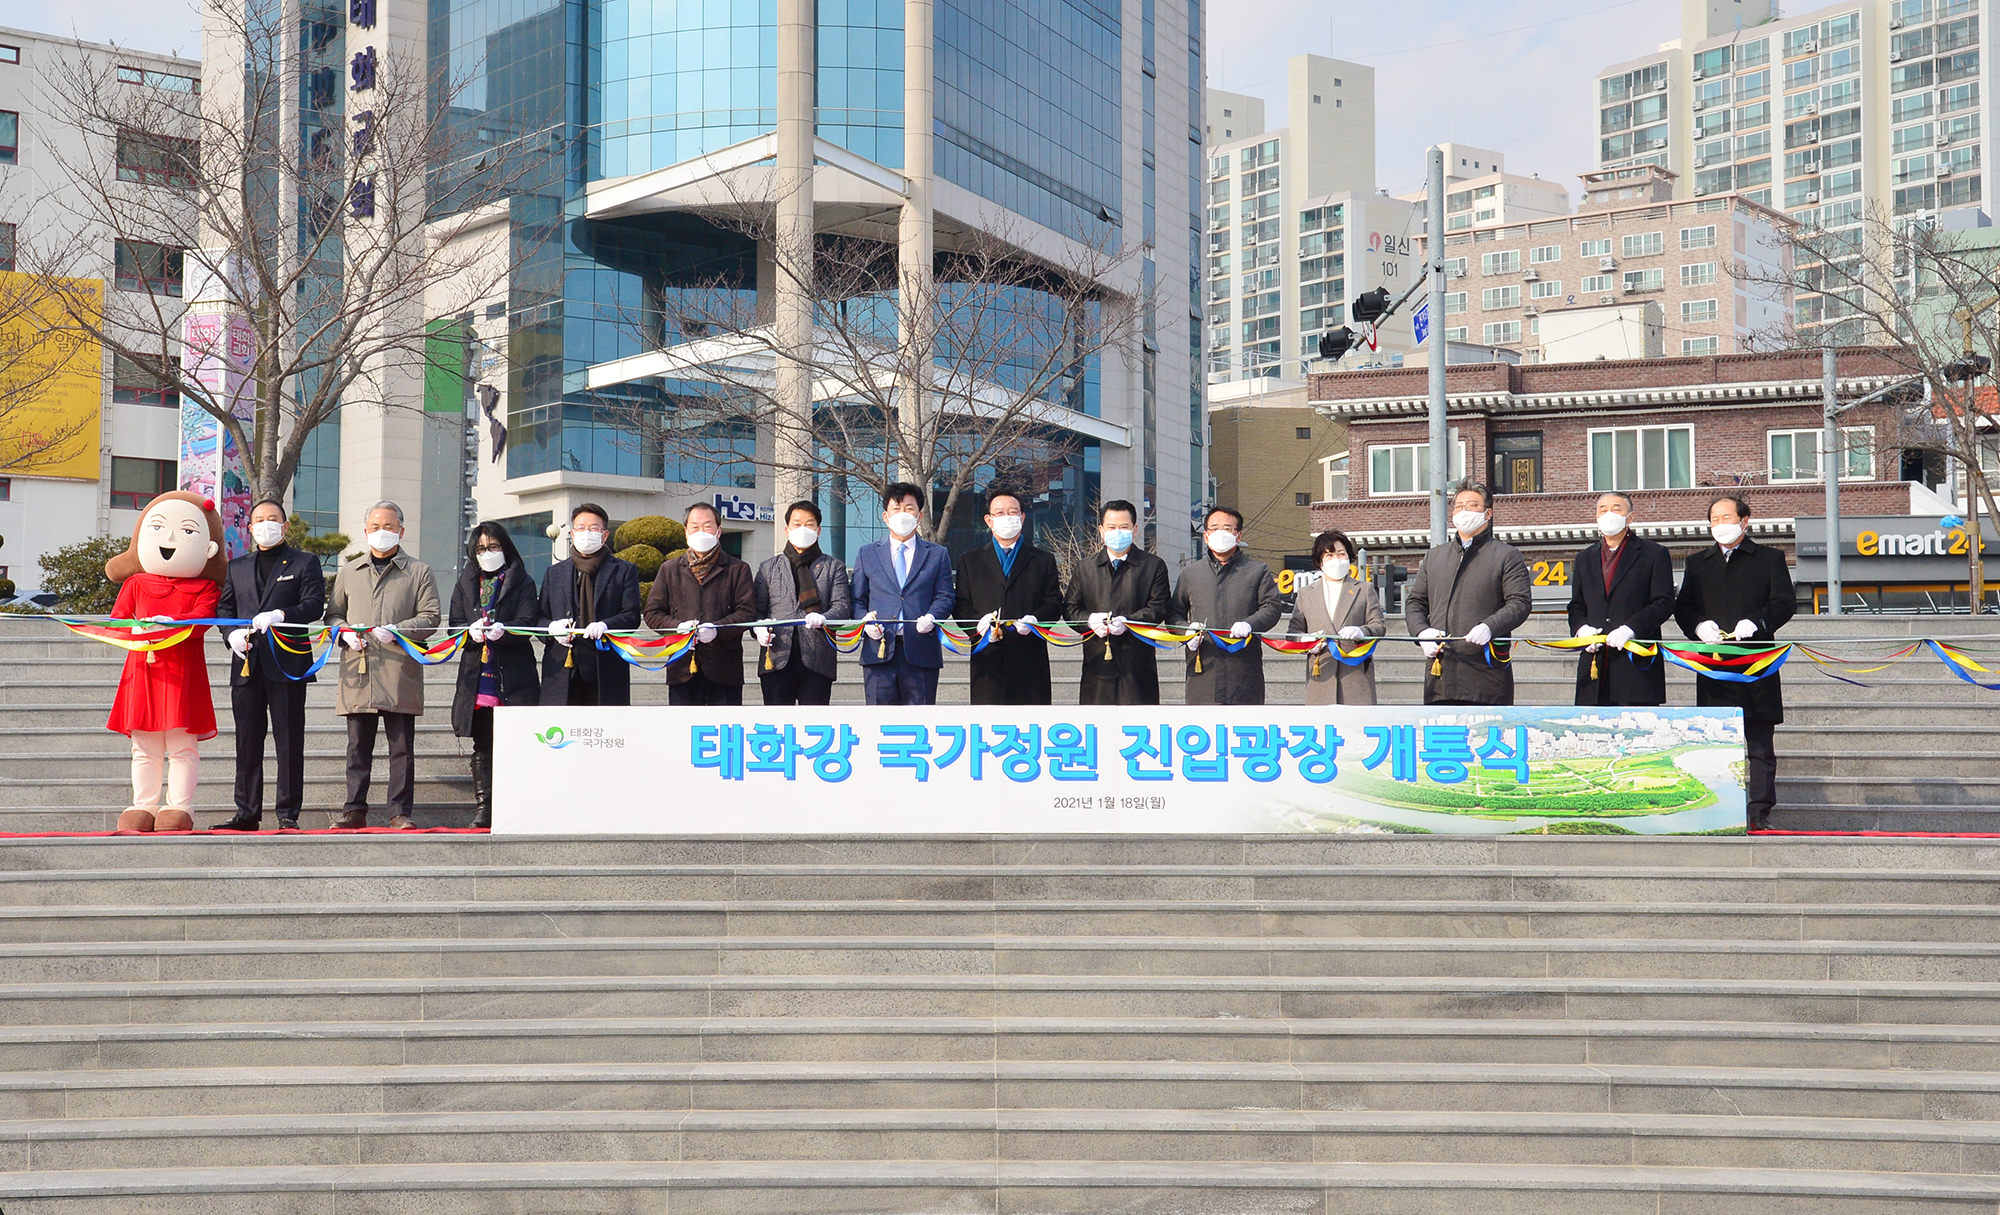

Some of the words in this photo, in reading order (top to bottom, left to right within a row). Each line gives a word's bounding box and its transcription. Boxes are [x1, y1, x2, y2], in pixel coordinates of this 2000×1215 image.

[350, 0, 377, 218] 태화교회
[1384, 234, 1410, 256] 일신
[1382, 261, 1398, 277] 101
[232, 328, 252, 344] 태화
[232, 341, 251, 356] 교회
[1533, 561, 1568, 586] 24
[570, 728, 604, 737] 태화강
[582, 738, 625, 749] 국가정원
[691, 723, 860, 783] 태화강
[877, 723, 1099, 783] 국가정원
[1119, 724, 1345, 783] 진입광장
[1361, 724, 1530, 784] 개통식
[1053, 796, 1093, 810] 2021년
[1098, 796, 1115, 810] 1월
[1120, 796, 1166, 810] 18일(월)
